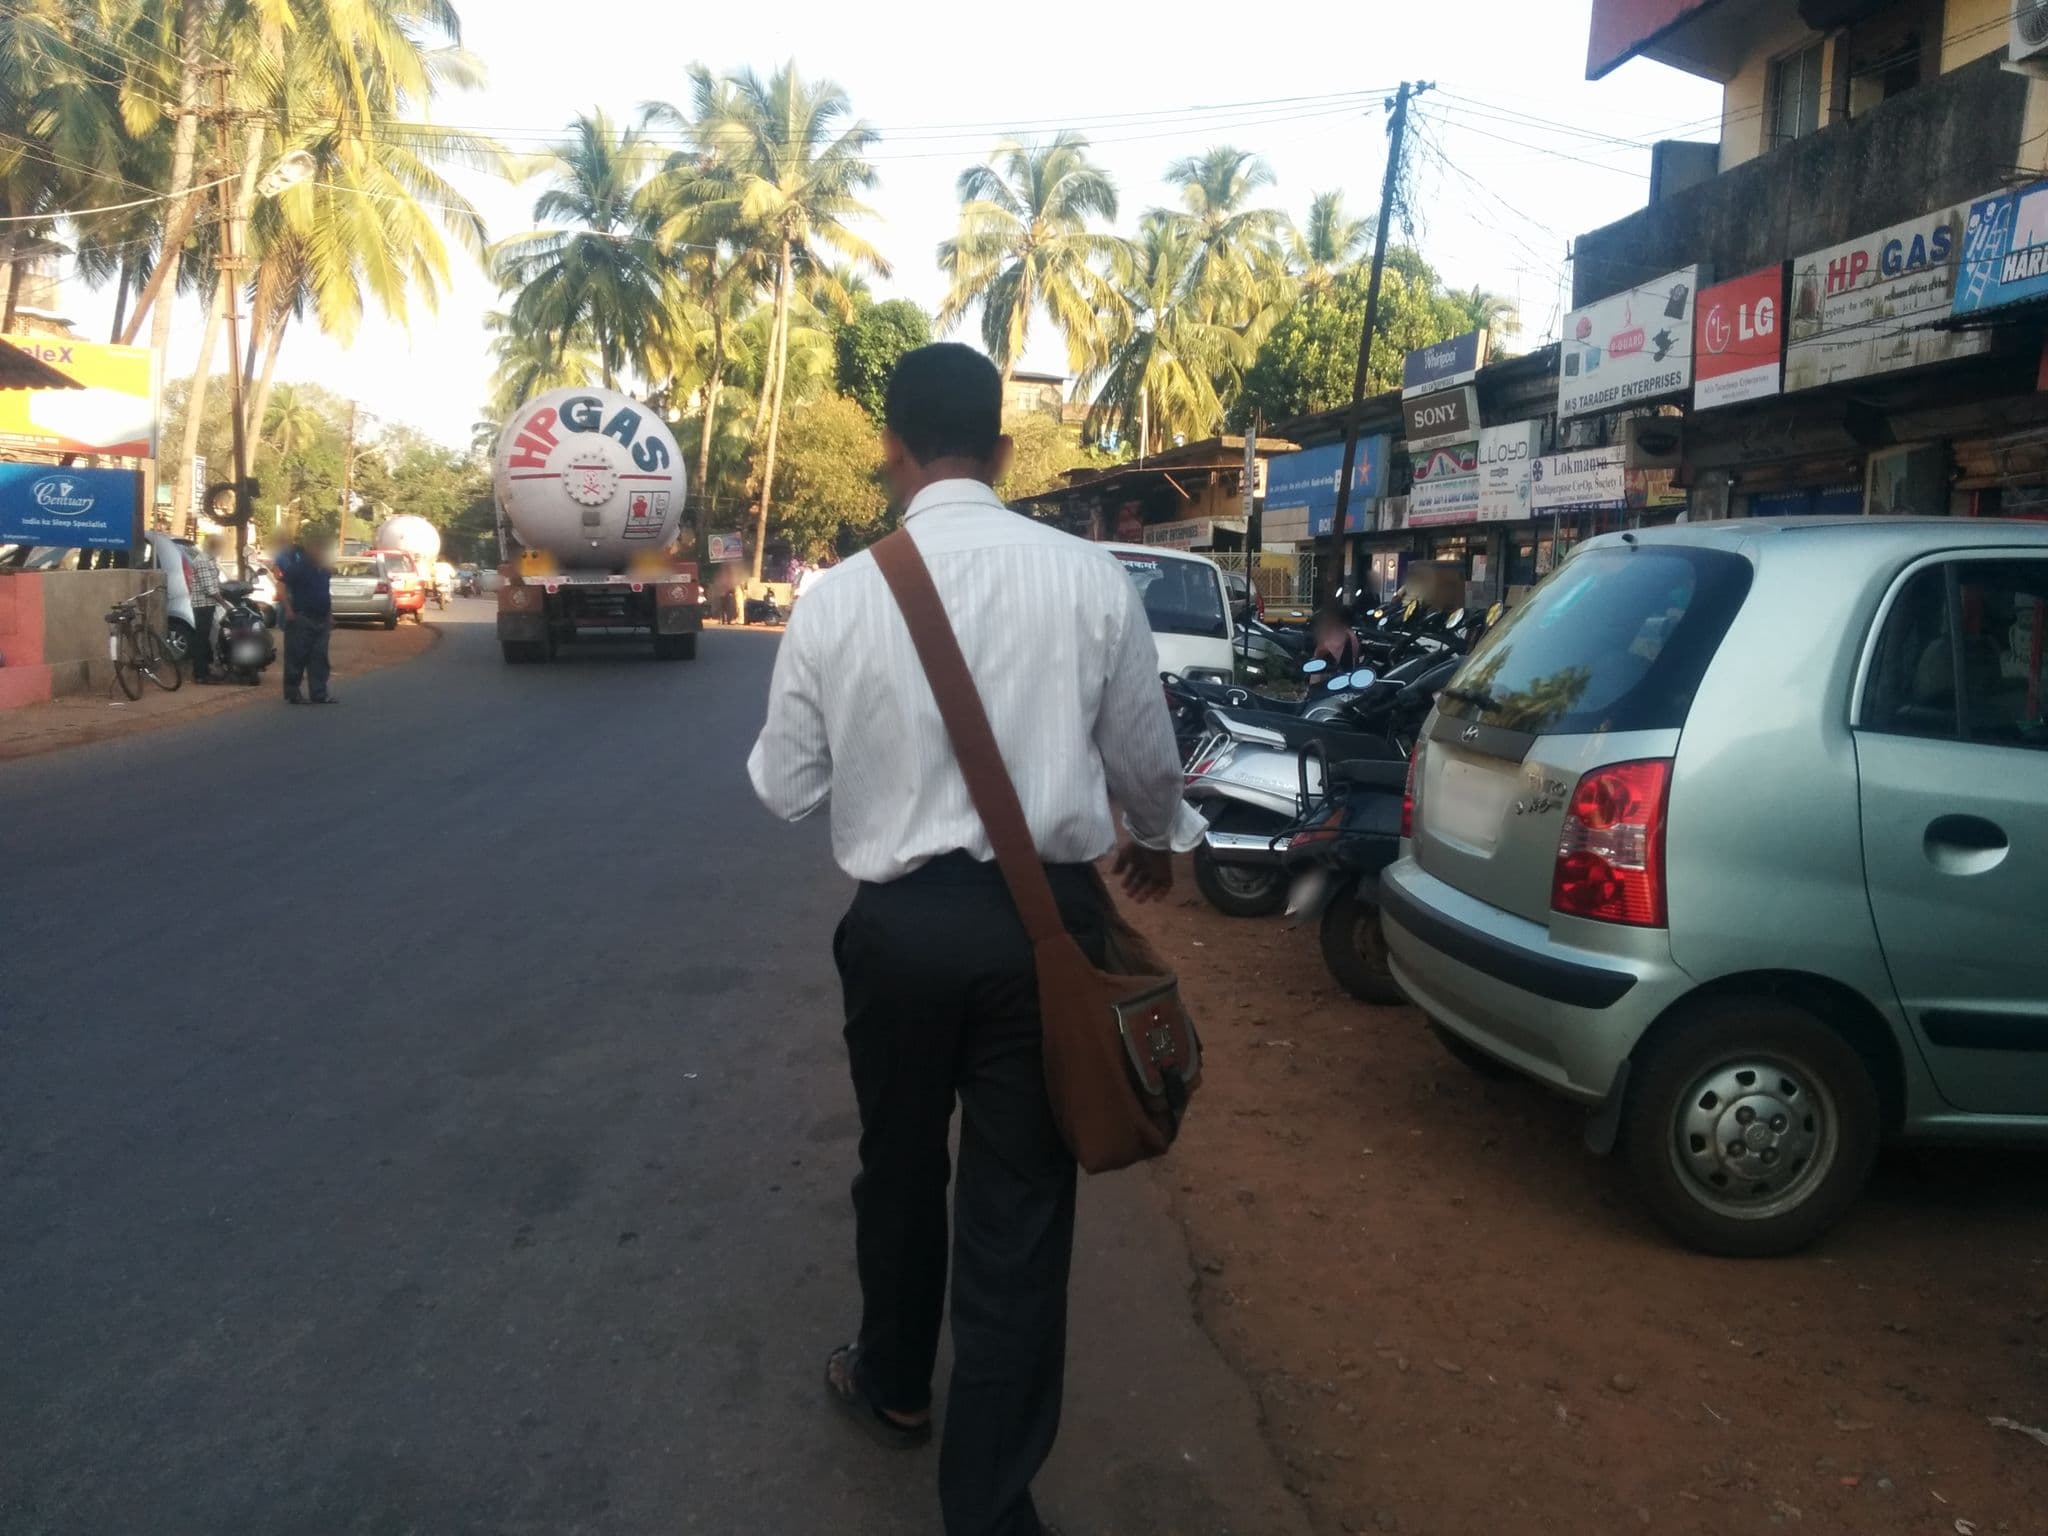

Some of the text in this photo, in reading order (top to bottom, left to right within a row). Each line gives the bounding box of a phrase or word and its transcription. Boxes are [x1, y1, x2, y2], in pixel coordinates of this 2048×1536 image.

[1826, 224, 1951, 293] HP GAS
[1738, 297, 1774, 342] LG
[1579, 386, 1619, 407] TARADEEP
[1621, 371, 1682, 397] ENTERPRISES
[1414, 404, 1457, 429] SONY
[509, 396, 670, 473] HP GAS
[1479, 441, 1528, 464] LLOYD
[1554, 456, 1608, 477] Lokmanya
[33, 482, 95, 507] Centuary
[52, 519, 72, 528] Sleep
[73, 520, 107, 528] Specialist
